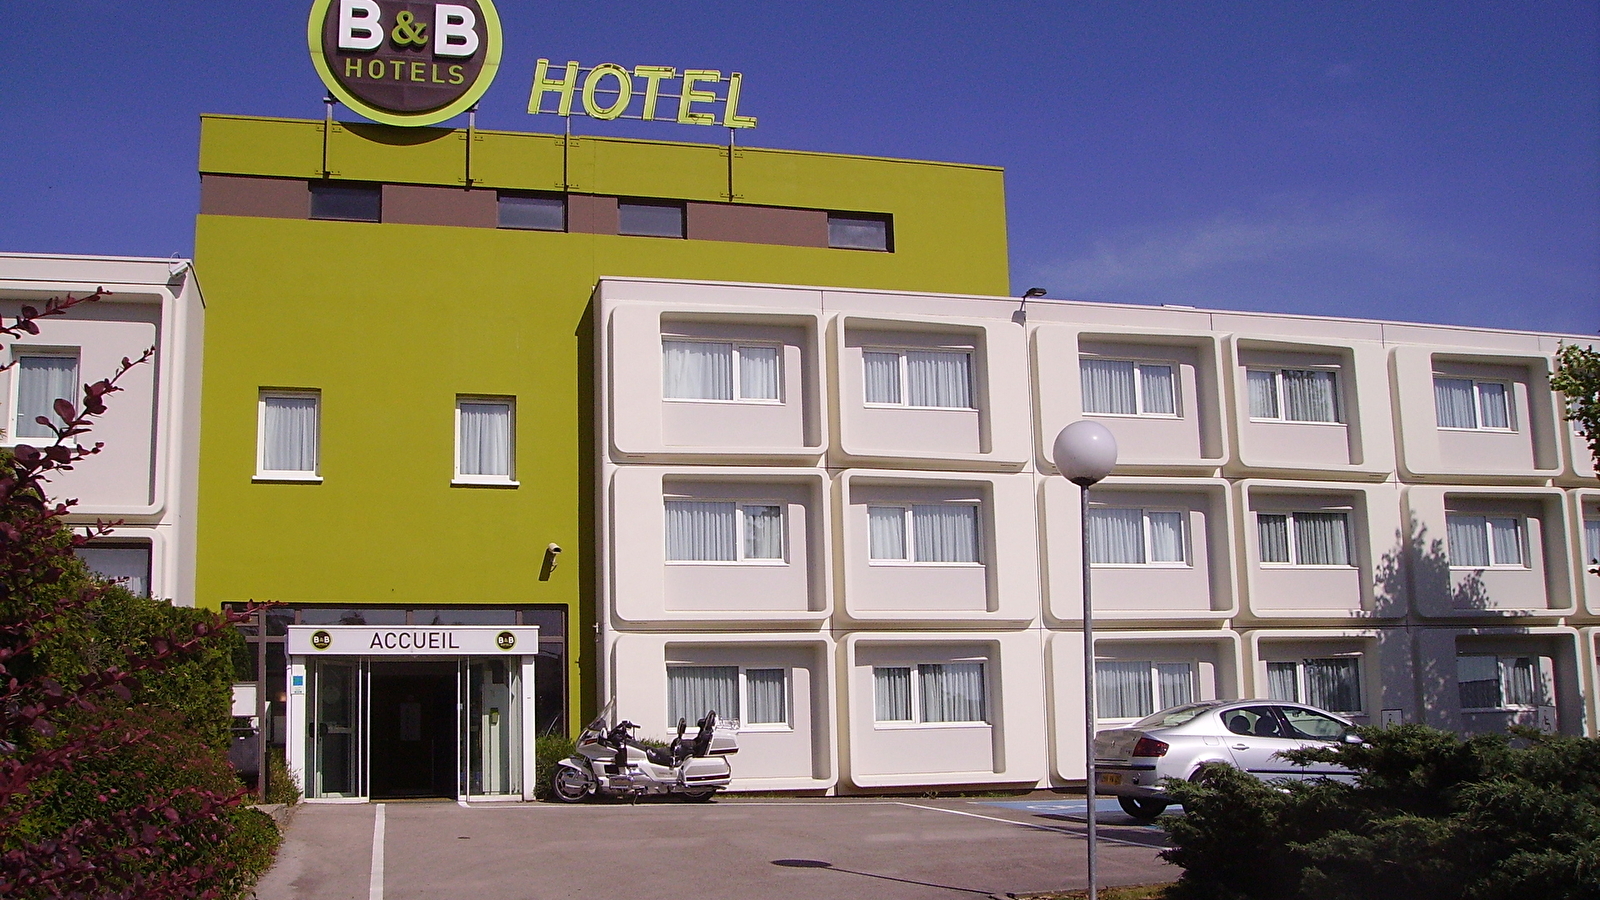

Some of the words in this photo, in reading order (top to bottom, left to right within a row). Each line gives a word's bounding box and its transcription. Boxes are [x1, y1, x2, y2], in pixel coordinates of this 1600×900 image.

[345, 58, 465, 85] HOTELS
[527, 58, 757, 129] HOTEL
[370, 632, 460, 649] ACCUEIL
